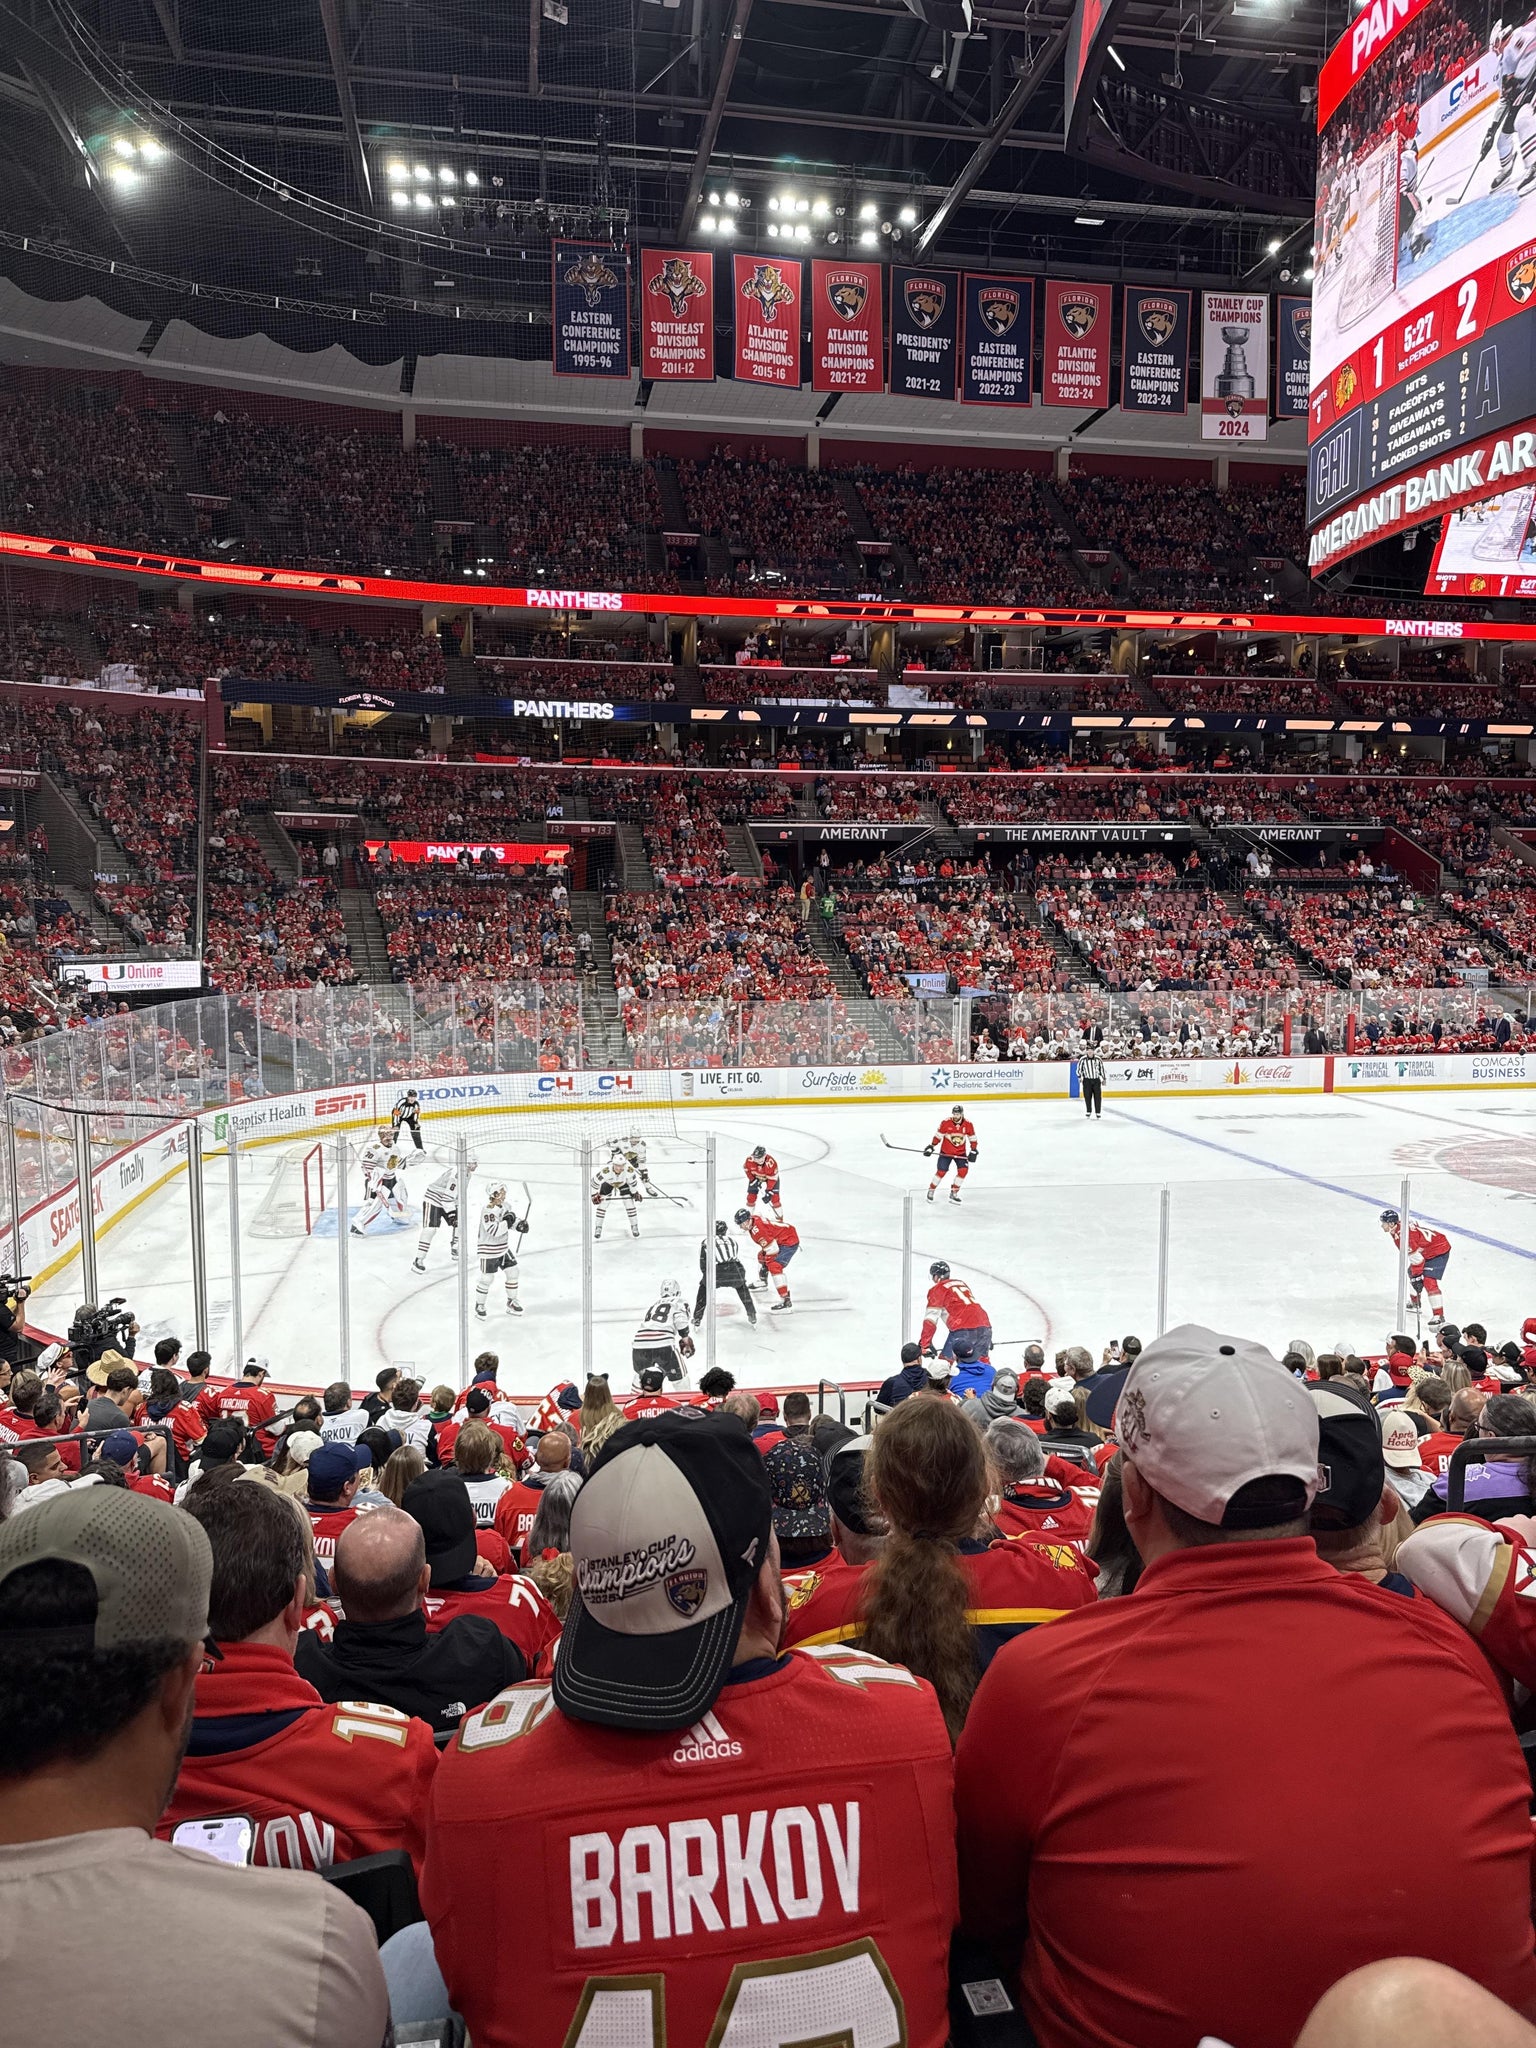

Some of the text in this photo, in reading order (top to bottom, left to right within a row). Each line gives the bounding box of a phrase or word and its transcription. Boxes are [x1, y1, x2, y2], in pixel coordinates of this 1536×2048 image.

[831, 276, 863, 285] FLORIDA
[909, 283, 941, 292] FLORIDA
[1063, 296, 1094, 305] FLORIDA
[1143, 303, 1173, 312] FLORIDA
[1207, 297, 1264, 311] STANLEY CUP
[1456, 279, 1478, 340] 2
[570, 311, 612, 325] EASTERN
[1209, 310, 1262, 324] CHAMPIONS
[562, 325, 621, 340] CONFERENCE
[650, 321, 705, 334] SOUTHEAST
[748, 324, 788, 341] ATLANTIC
[1403, 311, 1434, 353] 5:27
[657, 335, 698, 347] DIVISION
[827, 328, 869, 342] ATLANTIC
[896, 332, 951, 350] PRESIDENTS'
[563, 339, 620, 355] CHAMPIONS
[749, 337, 787, 353] DIVISION
[828, 343, 868, 356] DIVISION
[979, 342, 1017, 356] EASTERN
[1409, 340, 1439, 364] PERIOD
[649, 347, 706, 360] CHAMPIONS
[742, 348, 794, 367] CHAMPIONS
[906, 348, 941, 364] TROPHY
[1057, 346, 1097, 360] ATLANTIC
[1137, 352, 1174, 366] EASTERN
[572, 354, 612, 368] 1995-96
[661, 362, 695, 374] 2011-12
[821, 356, 875, 371] CHAMPIONS
[970, 355, 1025, 370] CONFERENCE
[1058, 360, 1096, 373] DIVISION
[1373, 336, 1384, 389] 1
[752, 364, 786, 380] 2015-16
[830, 371, 867, 384] 2021-22
[971, 369, 1023, 383] CHAMPIONS
[1129, 365, 1181, 380] CONFERENCE
[1405, 351, 1468, 394] HITS 6
[905, 376, 941, 392] 2021-22
[1051, 372, 1101, 387] CHAMPIONS
[1130, 378, 1179, 393] CHAMPIONS
[979, 382, 1015, 396] 2022-23
[1058, 386, 1094, 400] 2023-24
[1389, 368, 1470, 420] FACEOFFS % 62
[1137, 392, 1171, 406] 2023-24
[1389, 399, 1445, 435] GIVEAWAYS
[1461, 386, 1467, 400] 2
[1218, 421, 1250, 436] 2024
[1387, 415, 1446, 452] TAKEAWAYS
[1461, 404, 1466, 417] 1
[1381, 447, 1419, 472] BLOCKED
[1419, 428, 1452, 452] SHOTS
[1459, 421, 1466, 435] 2
[1315, 427, 1351, 505] CHI
[1308, 484, 1406, 567] AMERANT
[1405, 450, 1486, 514] BANK
[666, 536, 698, 546] 333 334
[1095, 553, 1107, 562] 302
[1499, 575, 1509, 596] 1
[526, 589, 623, 610] PANTHERS
[1385, 619, 1463, 637] PANTHERS
[339, 693, 362, 704] FLORIDA
[372, 694, 395, 707] HOCKEY
[513, 699, 614, 720] PANTHERS
[550, 825, 612, 835] 132 133
[820, 828, 888, 840] AMERANT
[1005, 829, 1148, 841] THE AMERANT VAULT
[1258, 829, 1322, 841] AMERANT
[127, 964, 163, 979] Online
[921, 978, 946, 988] Online
[1361, 1062, 1388, 1071] TROPICAL
[1408, 1061, 1435, 1069] TROPICAL
[1472, 1056, 1526, 1068] COMCAST
[700, 1072, 763, 1084] LIVE. FIT. GO.
[802, 1070, 857, 1088] Surfside
[953, 1068, 1024, 1079] Broward Health
[1160, 1073, 1189, 1084] PANTHERS
[1472, 1068, 1526, 1079] BUSINESS
[538, 1076, 573, 1092] CH
[598, 1075, 633, 1090] CH
[953, 1081, 983, 1089] Pediatric
[417, 1084, 501, 1100] HONDA
[561, 1090, 584, 1098] Hunter
[621, 1088, 644, 1096] Hunter
[314, 1093, 367, 1117] ESPN
[232, 1103, 306, 1133] Baptist Health
[119, 1153, 144, 1189] finally
[220, 1397, 249, 1410] TKACHUK
[590, 1534, 676, 1571] STANLEY CUP
[577, 1538, 696, 1598] Champions
[669, 1572, 704, 1586] FLORIDA
[440, 1706, 458, 1715] NORTH
[672, 1738, 743, 1763] adidas
[568, 1800, 861, 1950] BARKOV
